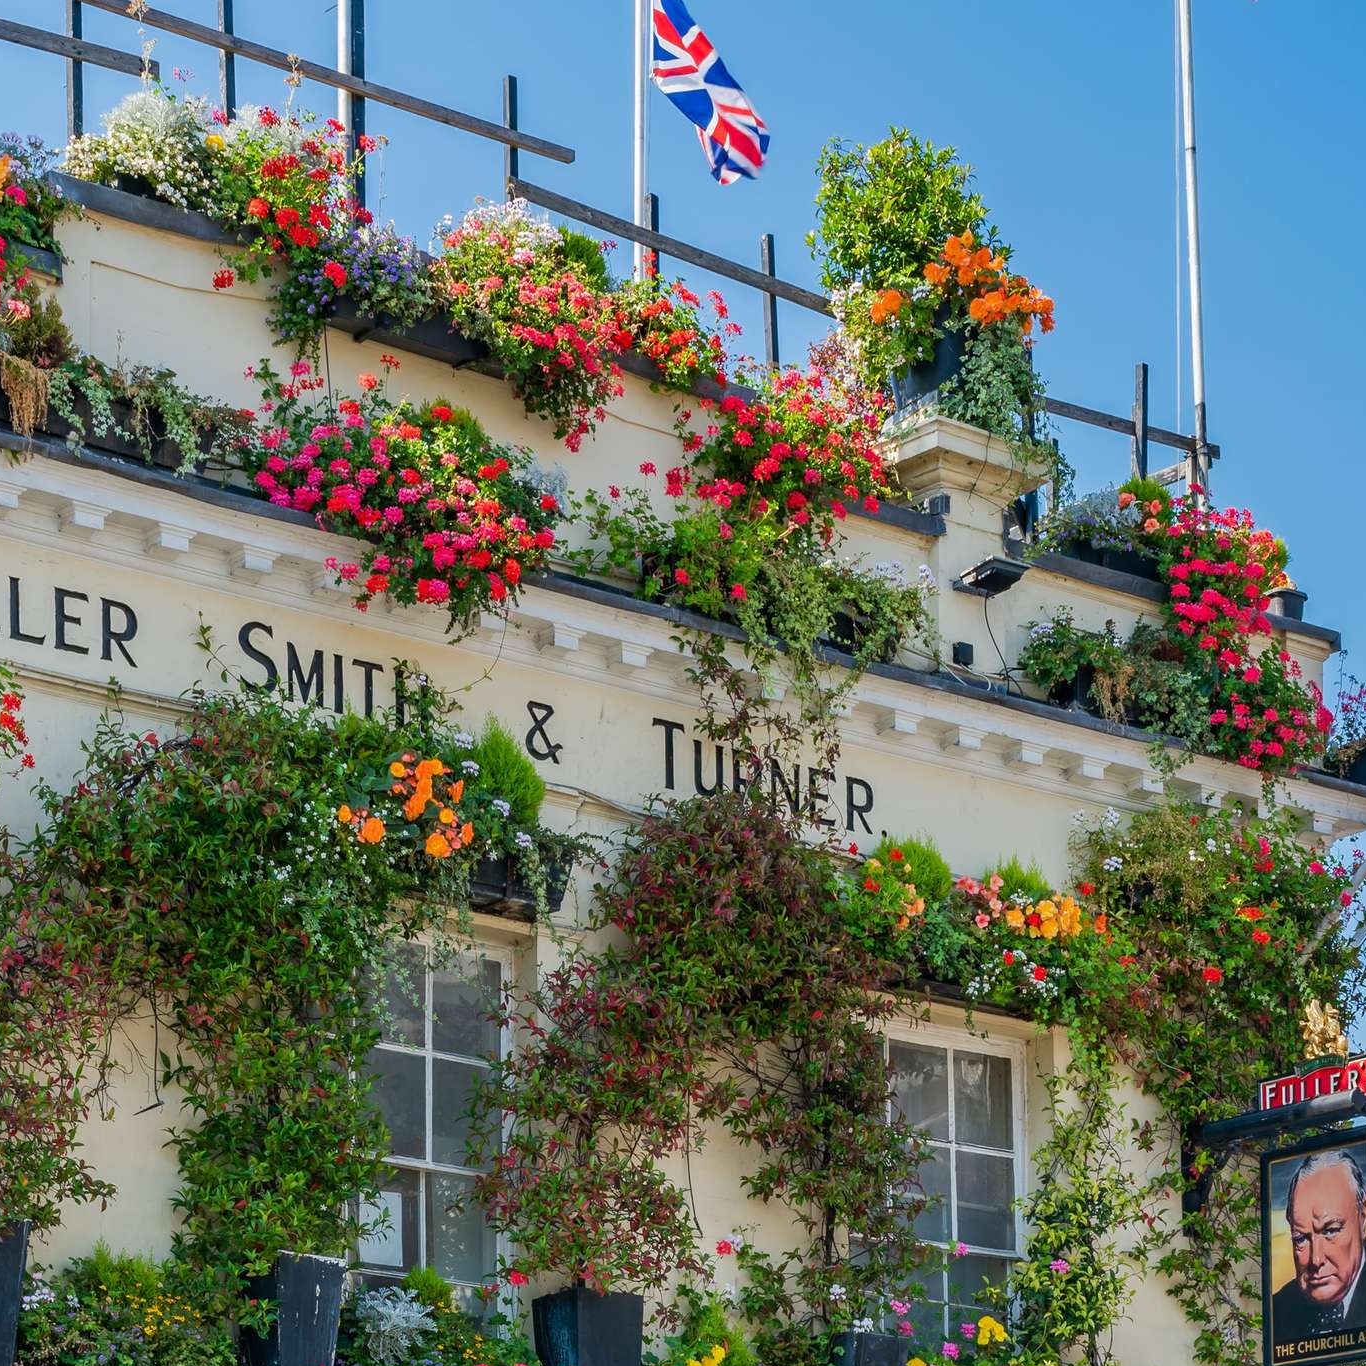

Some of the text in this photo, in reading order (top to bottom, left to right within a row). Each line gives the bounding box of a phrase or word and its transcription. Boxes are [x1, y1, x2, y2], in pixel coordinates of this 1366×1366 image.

[525, 700, 563, 764] &
[1276, 1343, 1295, 1357] THE
[1297, 1333, 1356, 1353] CHURCHILL
